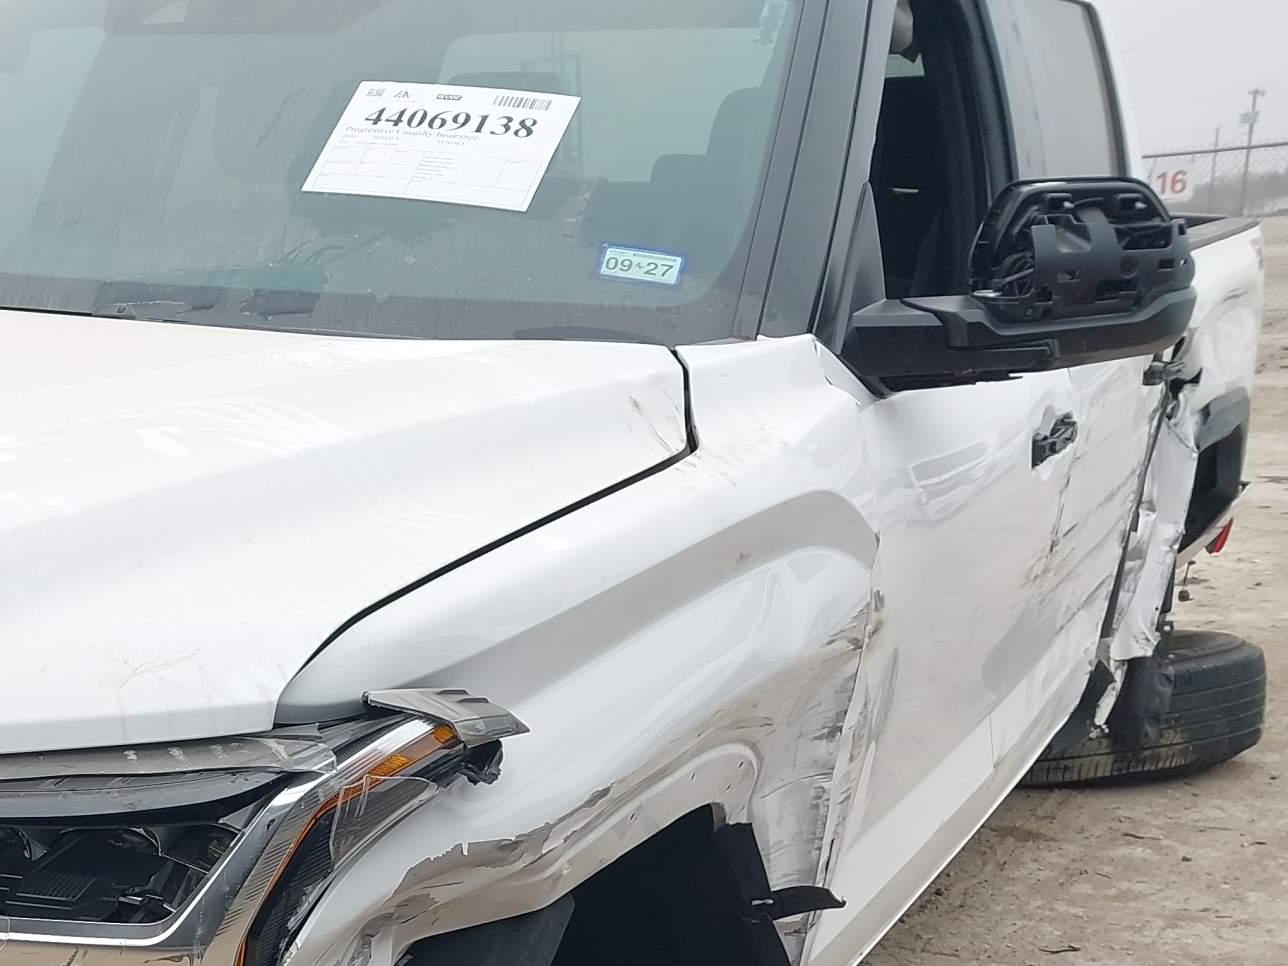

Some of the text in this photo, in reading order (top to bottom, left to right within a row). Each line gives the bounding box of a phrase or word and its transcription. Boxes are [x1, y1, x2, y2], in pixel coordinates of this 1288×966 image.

[364, 107, 538, 138] 44069138
[1156, 169, 1187, 194] 16
[605, 256, 633, 272] 09
[644, 261, 674, 277] 27
